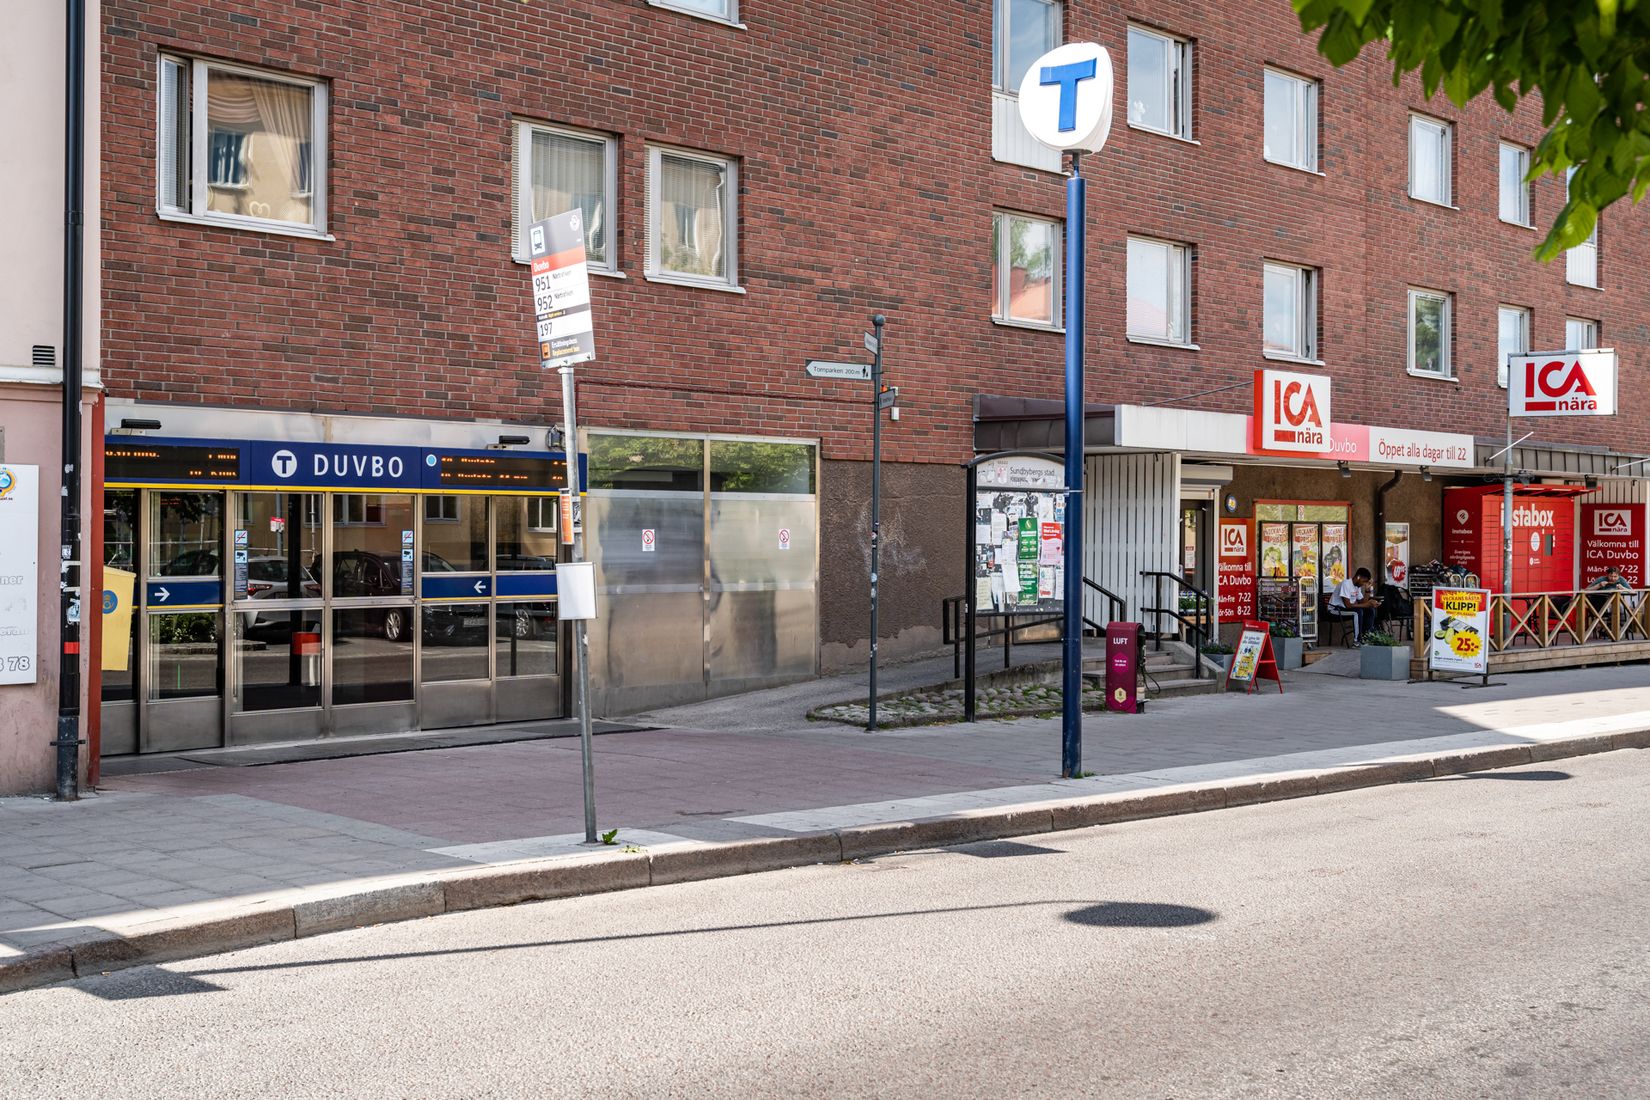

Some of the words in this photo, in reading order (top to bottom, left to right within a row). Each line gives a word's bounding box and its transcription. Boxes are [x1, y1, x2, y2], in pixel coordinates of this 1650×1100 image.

[1039, 57, 1097, 133] T
[533, 261, 549, 272] Duvbo
[536, 275, 551, 292] 951
[537, 295, 553, 311] 952
[540, 322, 553, 336] 197
[1525, 360, 1597, 398] ICA
[1274, 380, 1323, 428] ICA
[1558, 397, 1597, 411] nära
[1297, 428, 1323, 444] nära
[1379, 438, 1405, 459] Öppet
[1407, 443, 1420, 457] alla
[1423, 444, 1444, 463] dagar
[1446, 445, 1456, 460] till
[1457, 447, 1466, 460] 22
[314, 454, 403, 478] DUVBO
[1010, 466, 1043, 477] Sundbybergs
[1501, 502, 1554, 527] istabox
[1599, 513, 1627, 527] ICA
[1224, 528, 1244, 546] ICA
[1587, 540, 1626, 548] Välkomna
[1628, 540, 1639, 548] till
[1586, 550, 1604, 558] ICA
[1606, 550, 1639, 559] Duvbo
[1218, 562, 1244, 571] älkomna
[1244, 562, 1252, 571] till
[1619, 565, 1639, 574] 7-22
[1230, 575, 1252, 585] Duvbo
[1238, 593, 1252, 602] 7-22
[1237, 606, 1251, 615] 8-22
[1446, 602, 1476, 611] KLIPP!
[1113, 637, 1128, 645] LUFT
[1456, 637, 1479, 652] 25:-
[8, 655, 30, 671] 78
